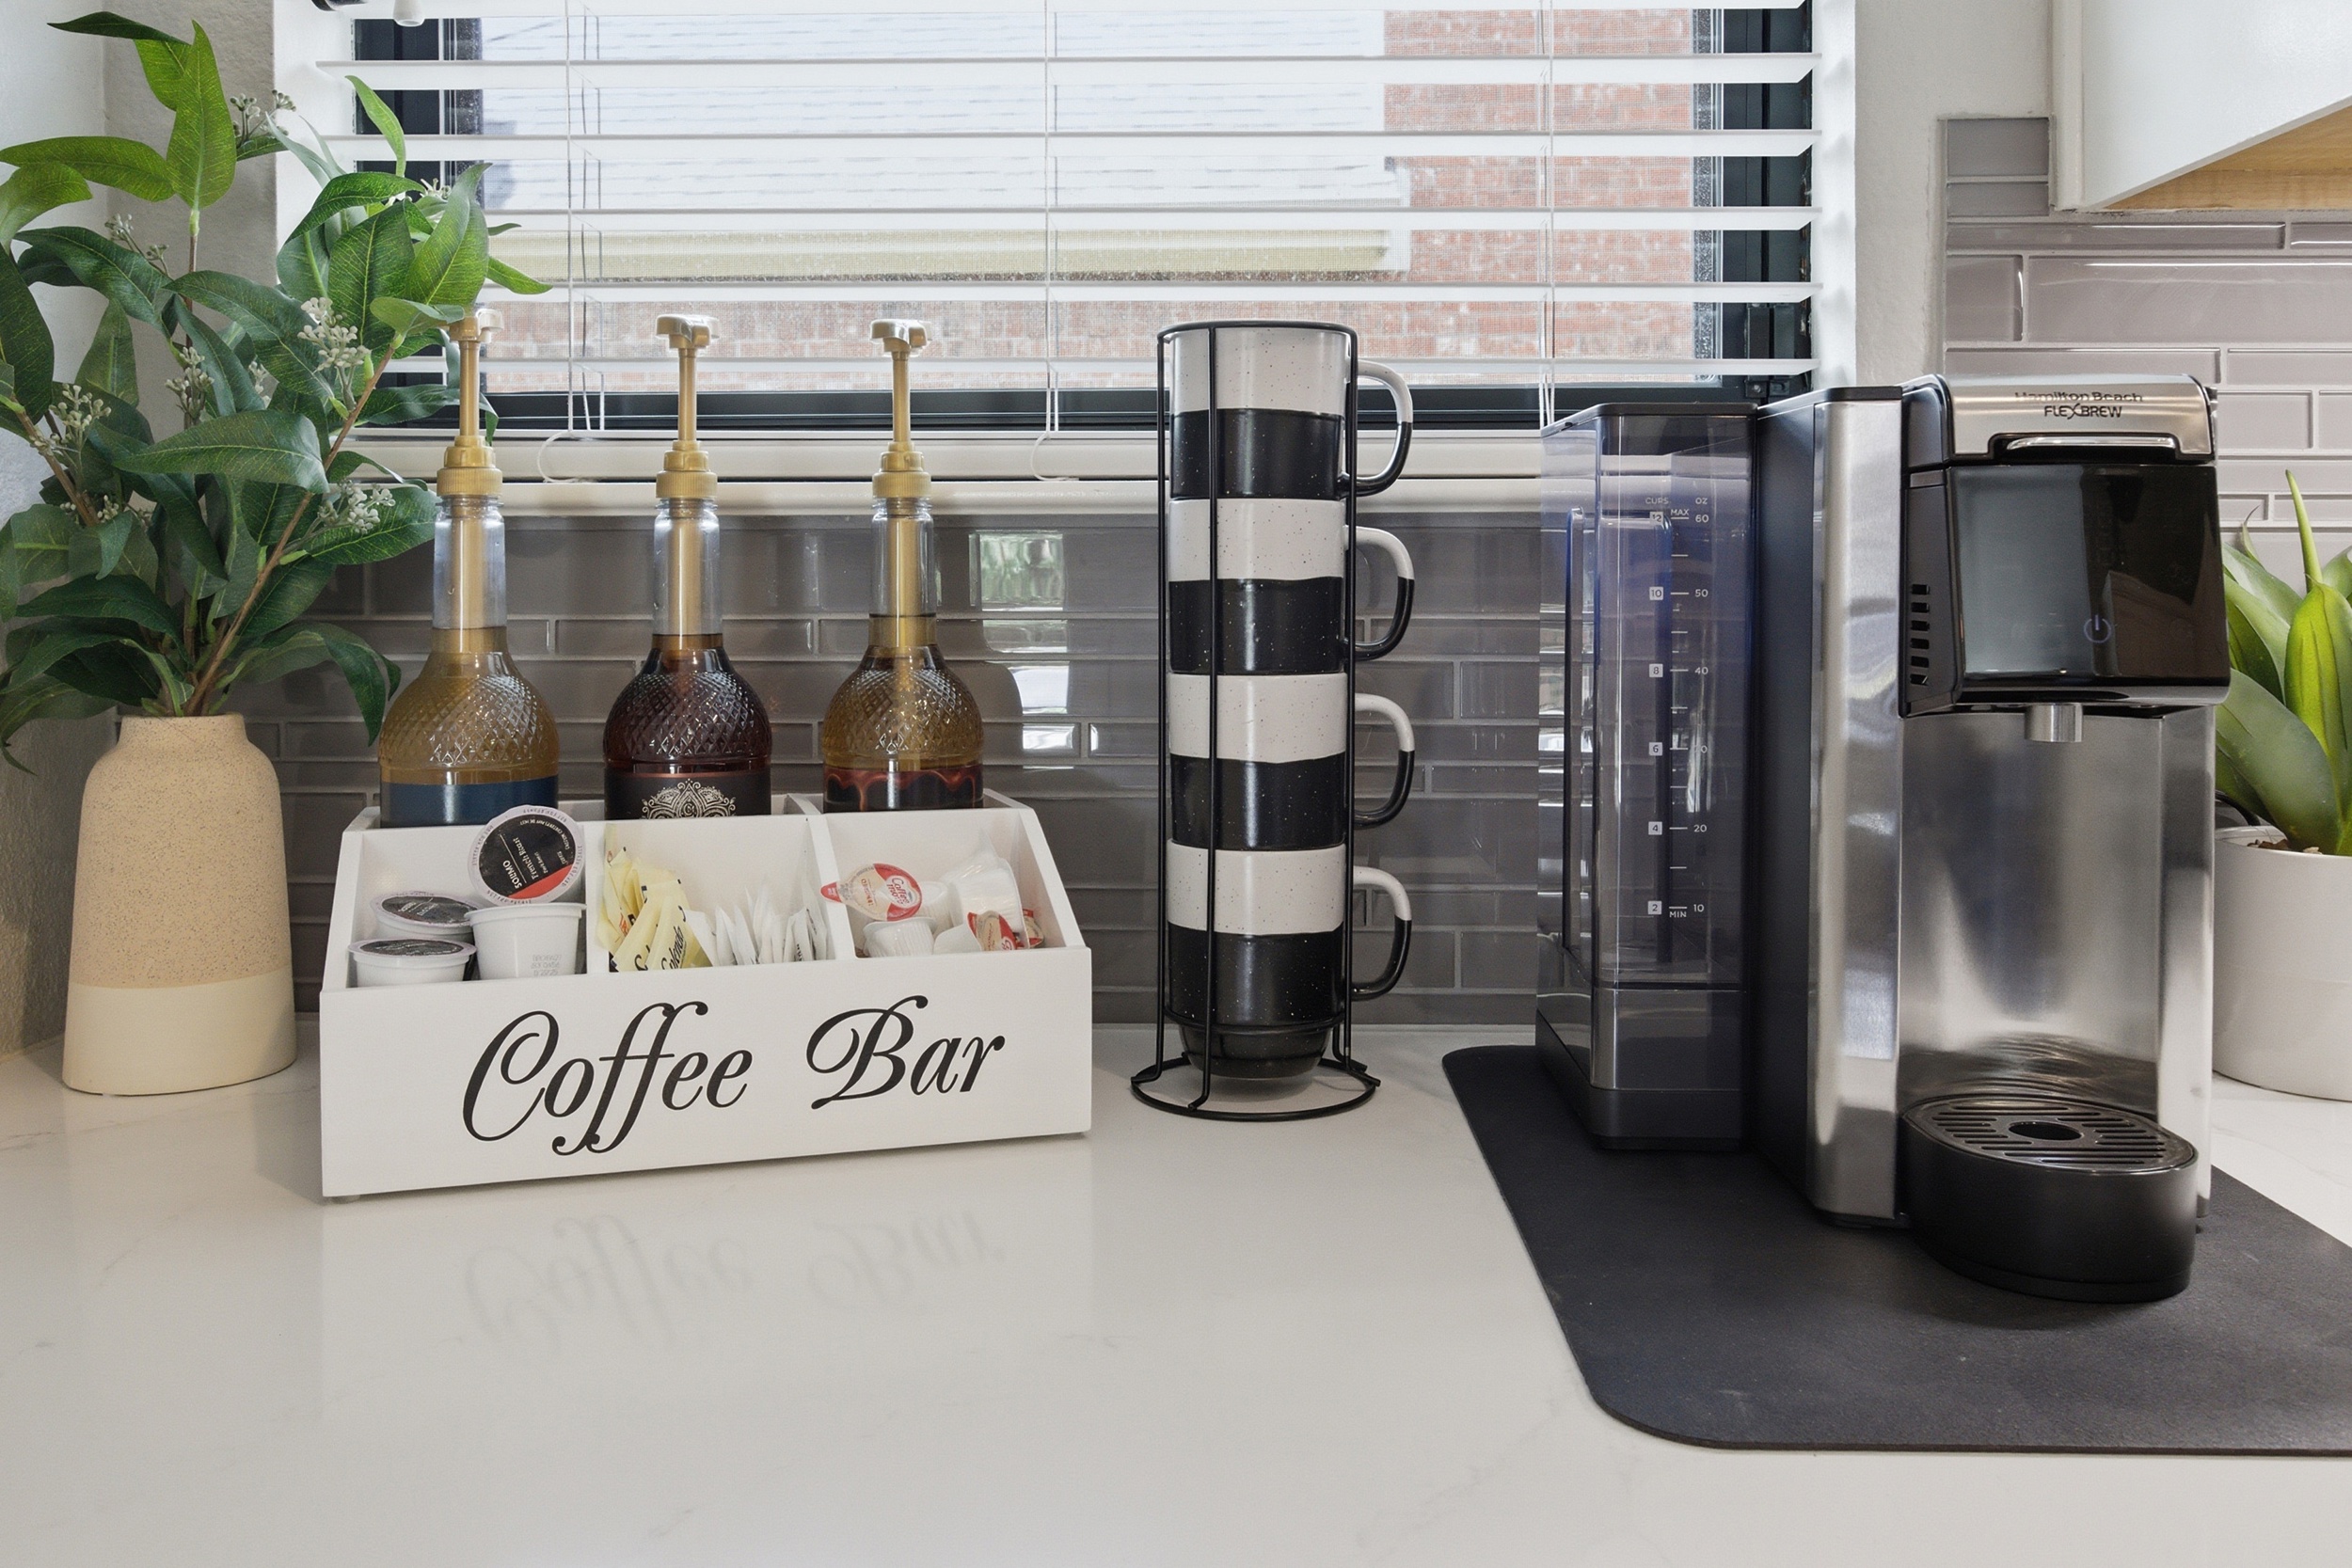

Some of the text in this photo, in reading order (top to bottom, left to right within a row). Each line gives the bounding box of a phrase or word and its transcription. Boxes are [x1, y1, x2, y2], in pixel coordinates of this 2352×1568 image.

[2014, 391, 2143, 403] Hamilton Beach
[2043, 403, 2122, 420] FLEXBREW
[1645, 497, 1669, 505] CUPS
[1694, 497, 1708, 505] OZ
[1670, 508, 1690, 516] MAX
[1651, 514, 1662, 523] 12
[1694, 514, 1709, 523] 60
[1651, 589, 1662, 598] 10
[1694, 589, 1708, 598] 50
[1694, 666, 1708, 675] 40
[1693, 824, 1708, 832] 20
[1693, 903, 1705, 912] 10
[463, 995, 1006, 1156] Coffee Bar
